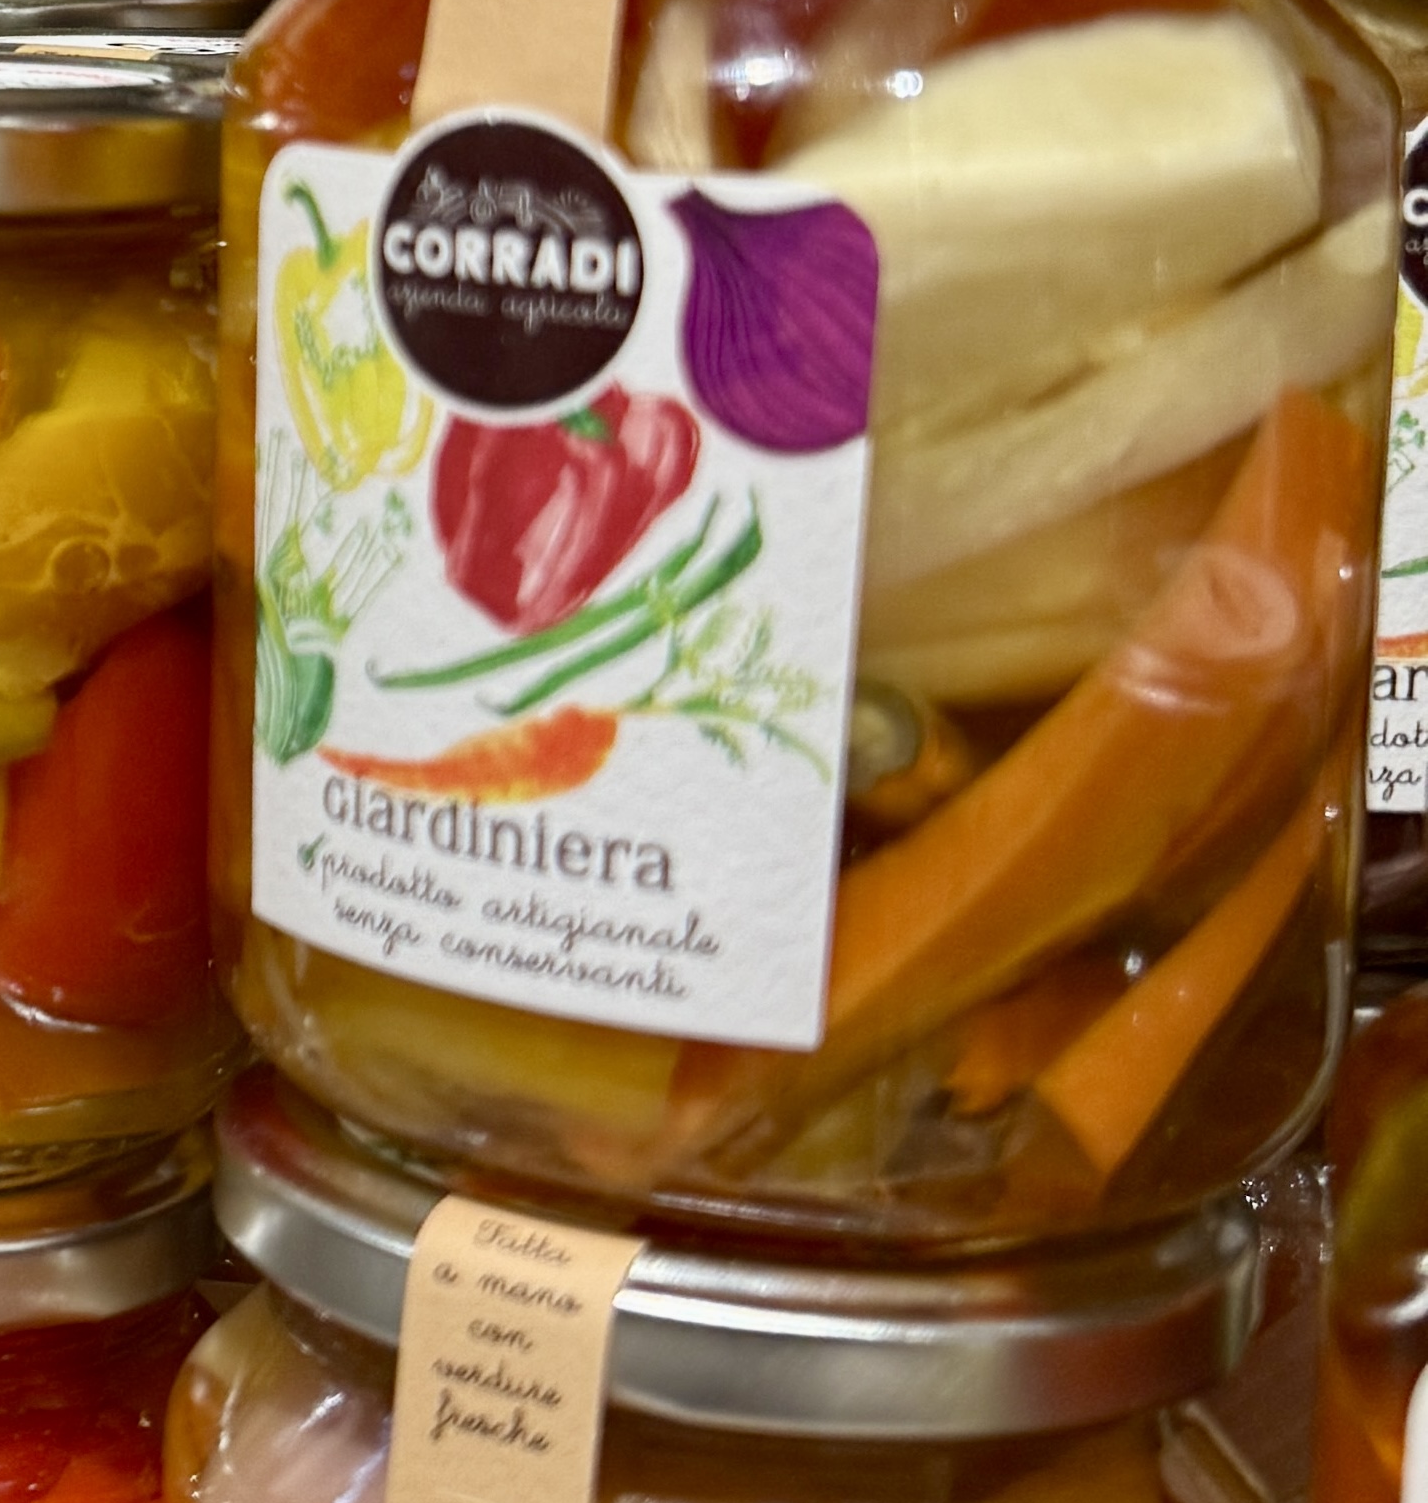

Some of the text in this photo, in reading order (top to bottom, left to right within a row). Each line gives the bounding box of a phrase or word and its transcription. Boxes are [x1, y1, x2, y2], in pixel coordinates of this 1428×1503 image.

[382, 220, 641, 297] CORRADI
[320, 850, 721, 956] prodotto artigianale
[332, 897, 689, 998] senza conservanti
[432, 1261, 584, 1314] a mano
[467, 1317, 534, 1353] con
[431, 1357, 563, 1407] verdure
[429, 1387, 550, 1452] fresche
